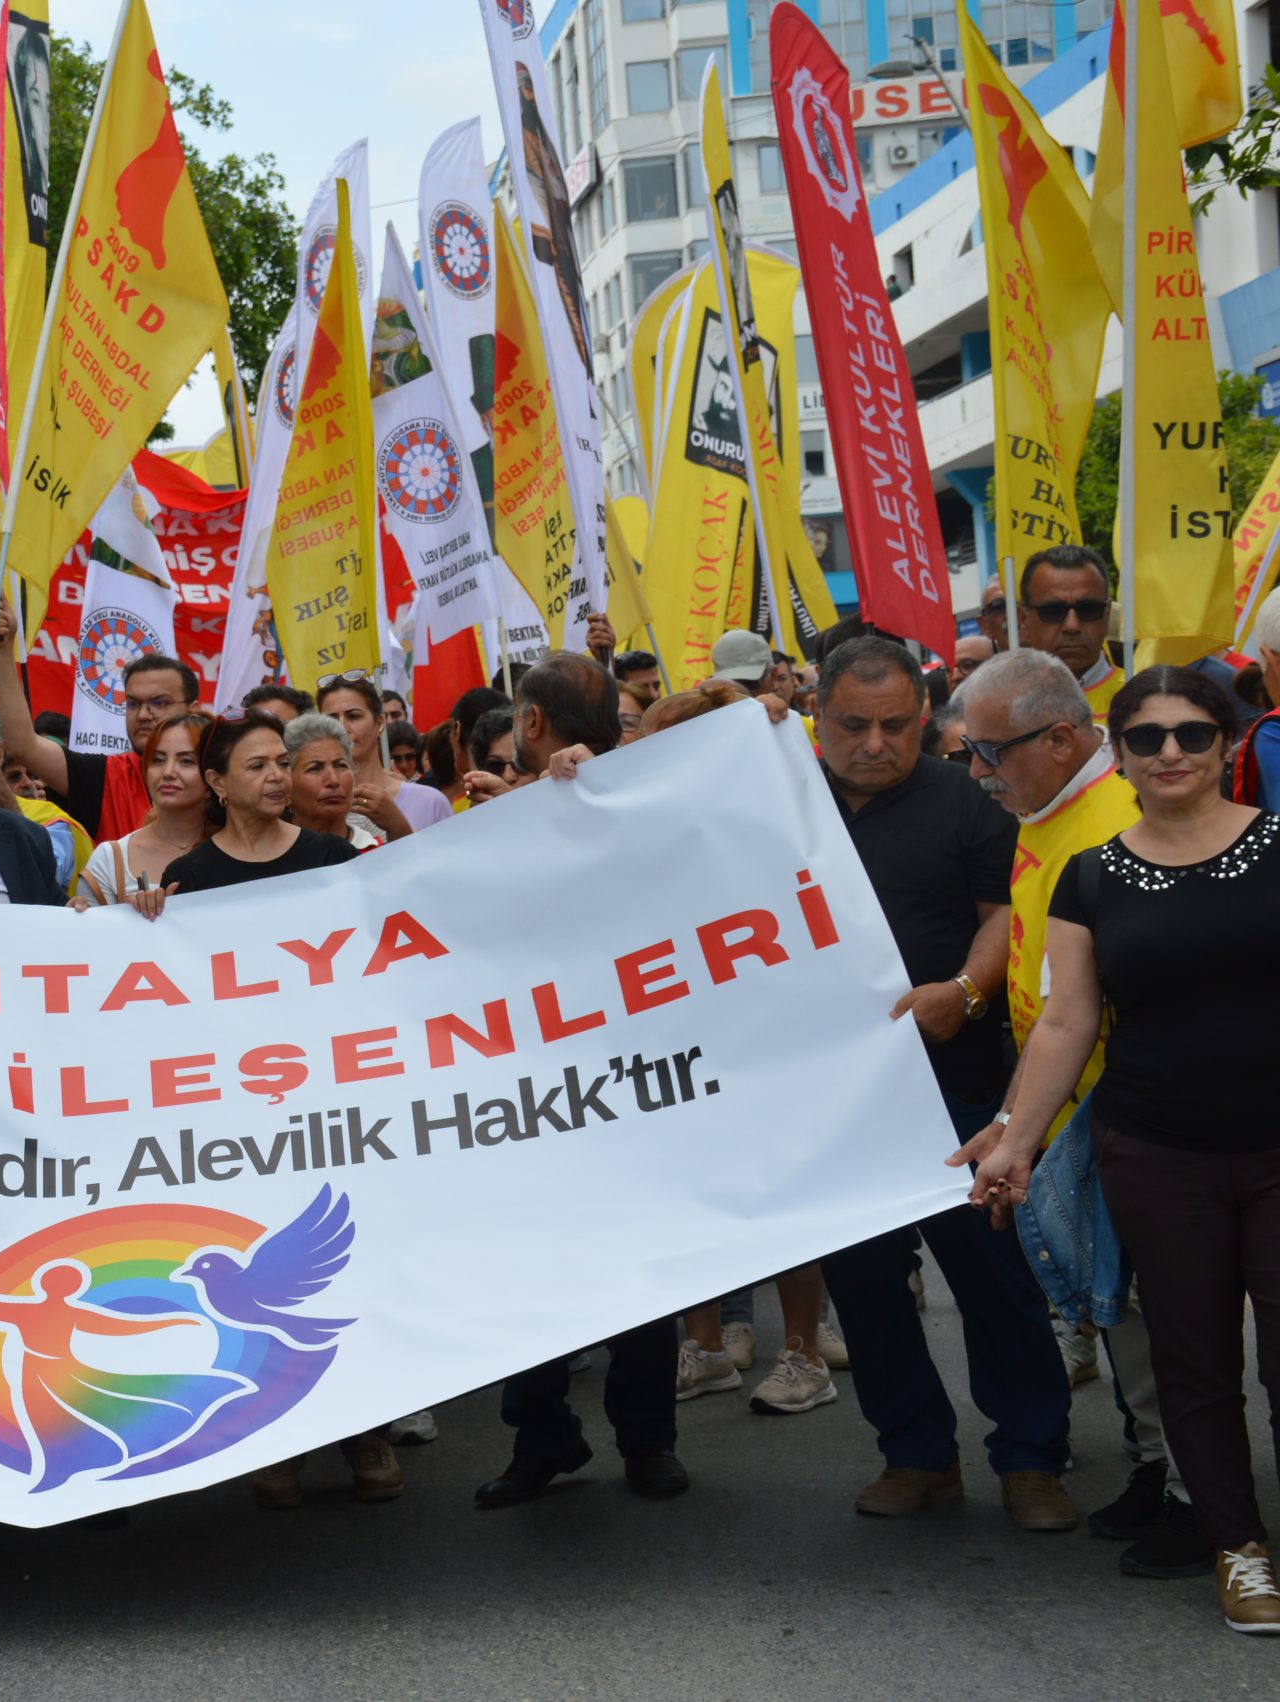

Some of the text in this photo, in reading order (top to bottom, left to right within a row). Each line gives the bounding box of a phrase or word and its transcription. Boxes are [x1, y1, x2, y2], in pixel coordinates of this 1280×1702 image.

[849, 79, 969, 124] USE
[105, 227, 141, 273] 2009
[1146, 226, 1194, 256] PİR
[1152, 318, 1209, 341] ALT
[72, 339, 134, 412] DERNEĞİ
[102, 334, 151, 391] ABDAL
[66, 379, 116, 440] ŞUBESİ
[830, 242, 914, 591] ALEVİ KÜLTÜR
[690, 430, 745, 462] ONURU
[855, 291, 939, 604] DERNEKLERİ
[1153, 421, 1226, 450] YUR
[690, 484, 729, 617] KOÇAK
[110, 610, 149, 632] ANADOLU
[509, 624, 543, 643] BEKTAŞ
[75, 732, 99, 746] HACI
[117, 1114, 398, 1192] Alevilik
[411, 1045, 721, 1156] Hakk'tır.
